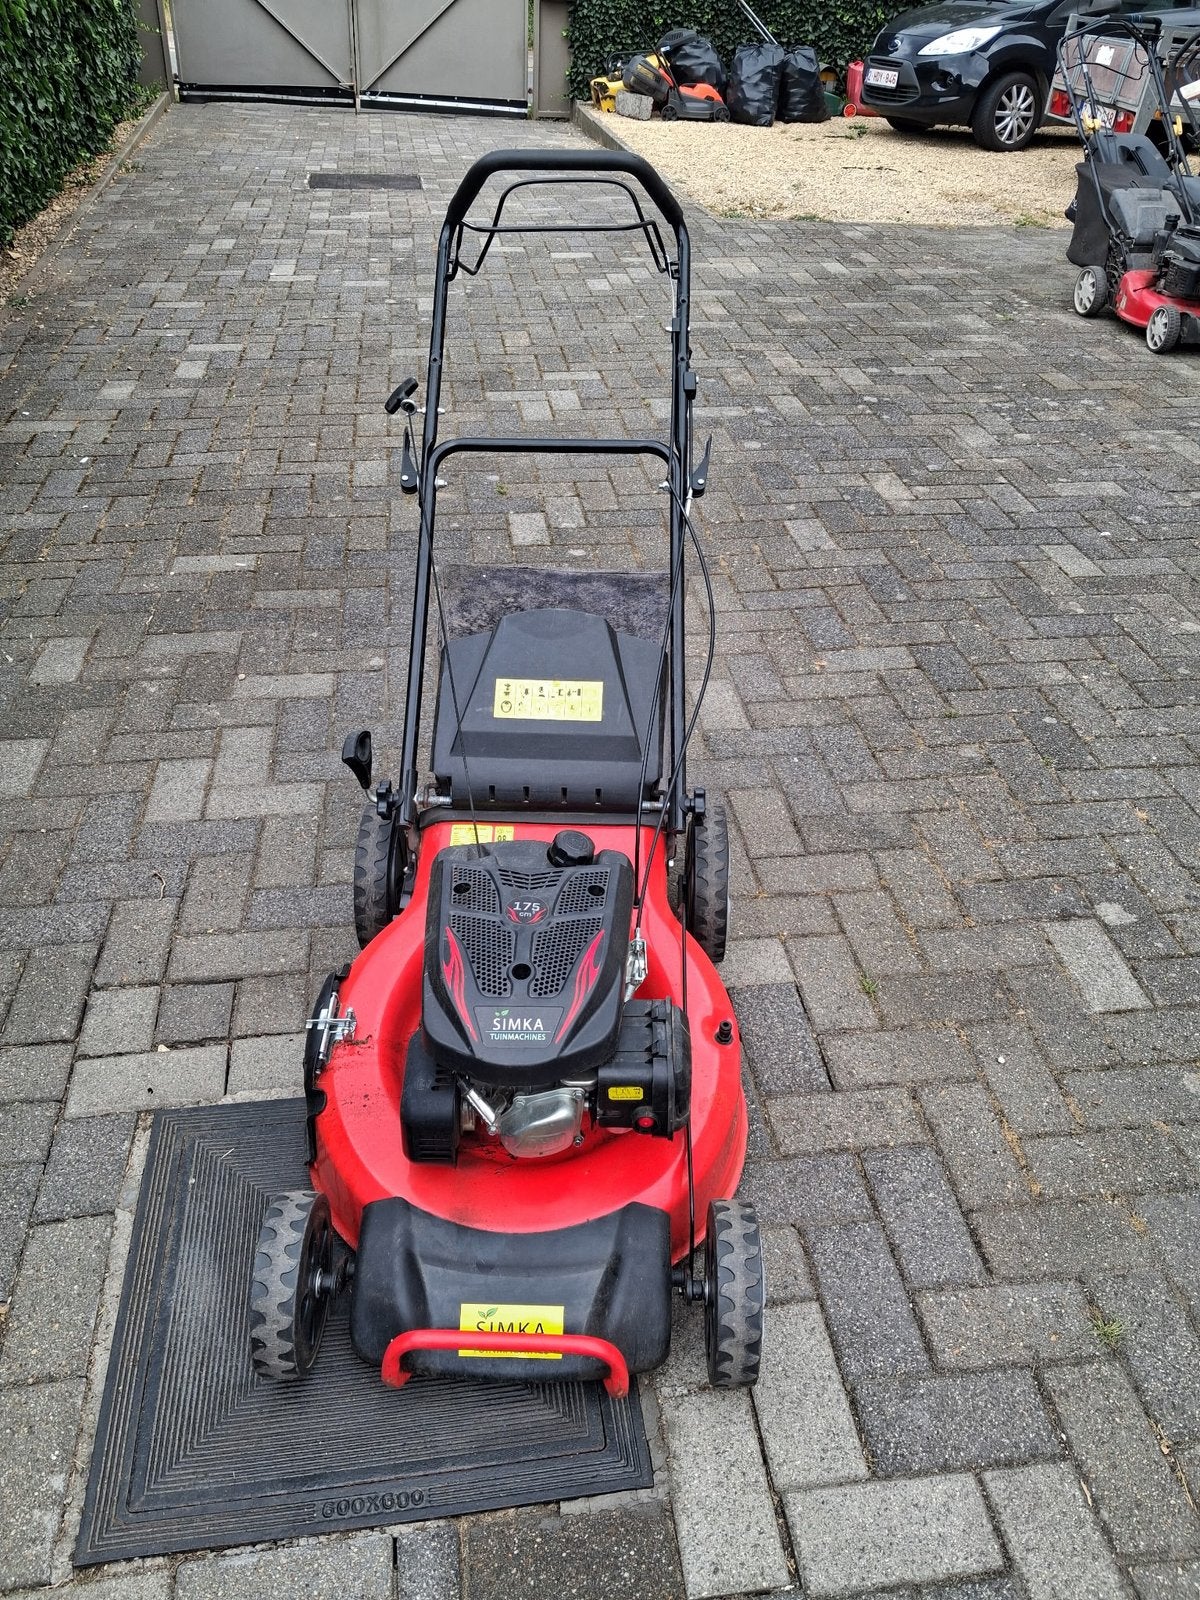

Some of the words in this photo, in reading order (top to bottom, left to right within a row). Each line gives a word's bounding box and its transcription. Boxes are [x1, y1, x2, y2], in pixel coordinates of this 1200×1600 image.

[513, 901, 541, 912] 175
[492, 1018, 544, 1031] SIMKA
[490, 1033, 546, 1041] TUINMACHINES
